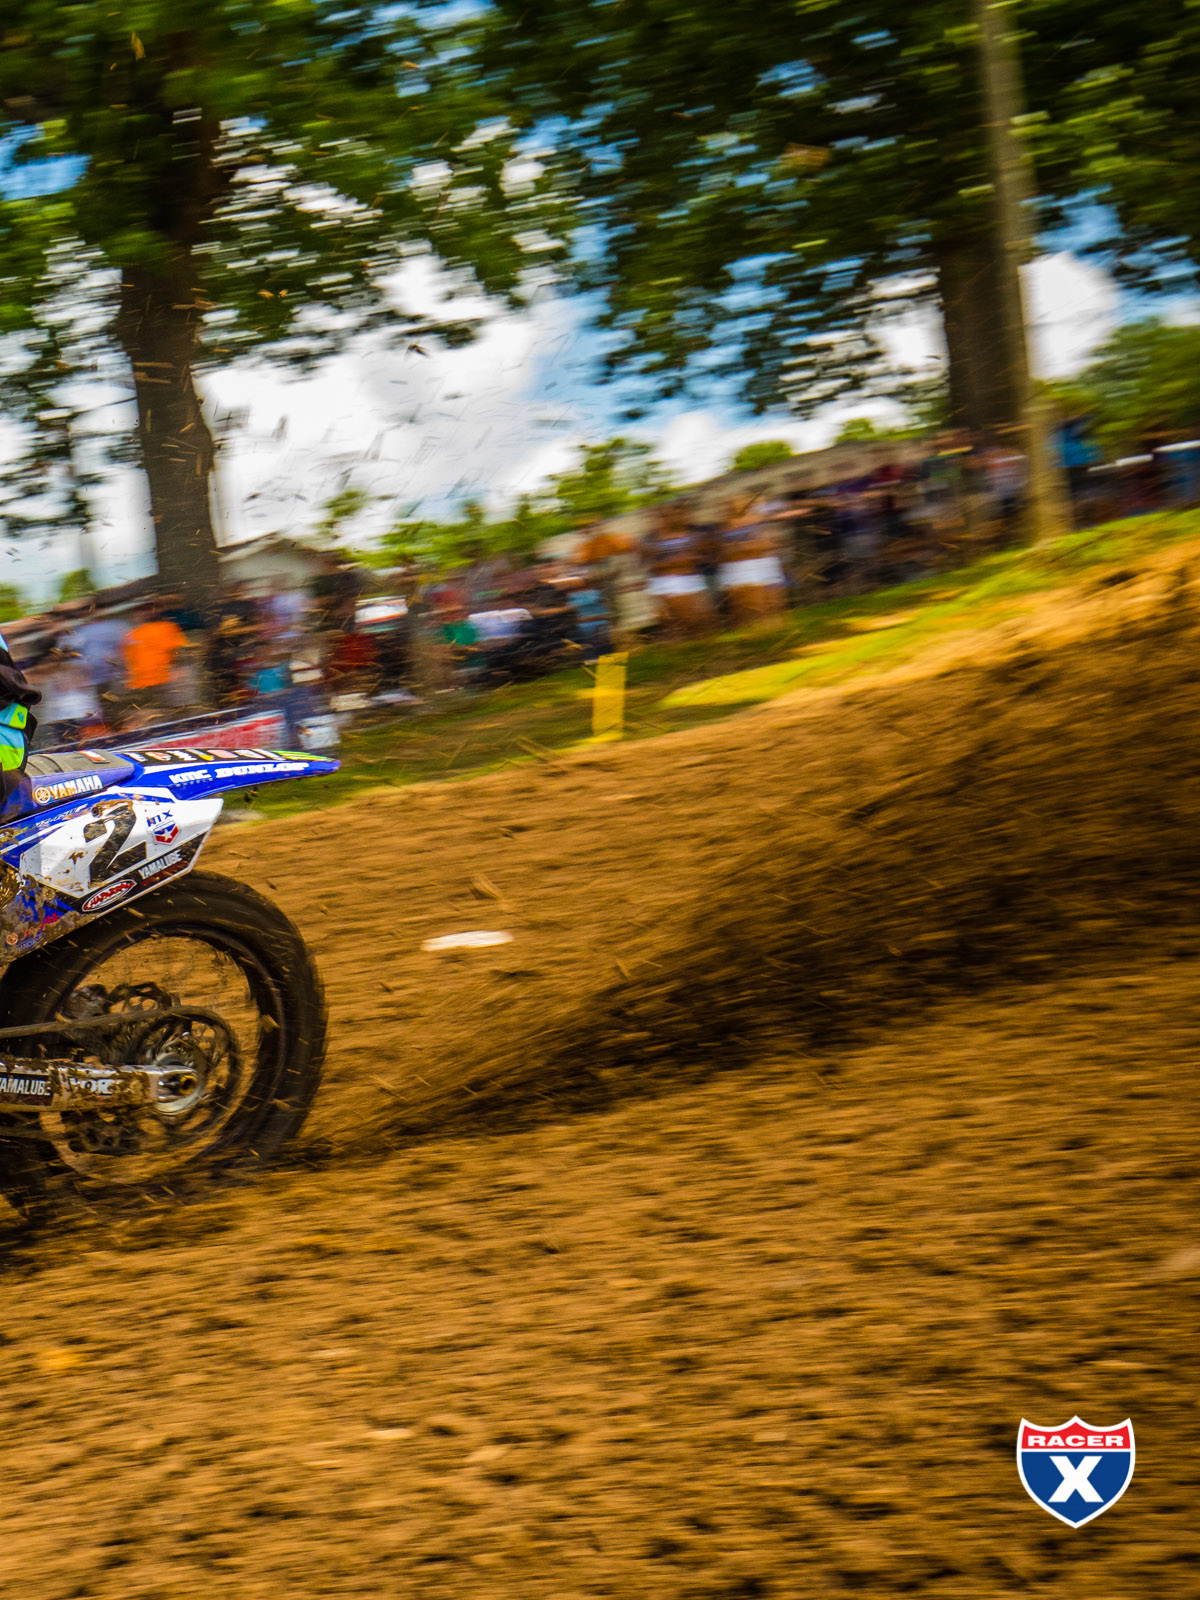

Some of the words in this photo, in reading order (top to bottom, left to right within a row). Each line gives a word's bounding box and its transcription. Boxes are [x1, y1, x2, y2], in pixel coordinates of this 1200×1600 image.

[215, 762, 310, 779] DUNLOP
[48, 775, 104, 800] YAMAHA
[83, 803, 147, 888] 2
[138, 849, 183, 880] YAMALUBE
